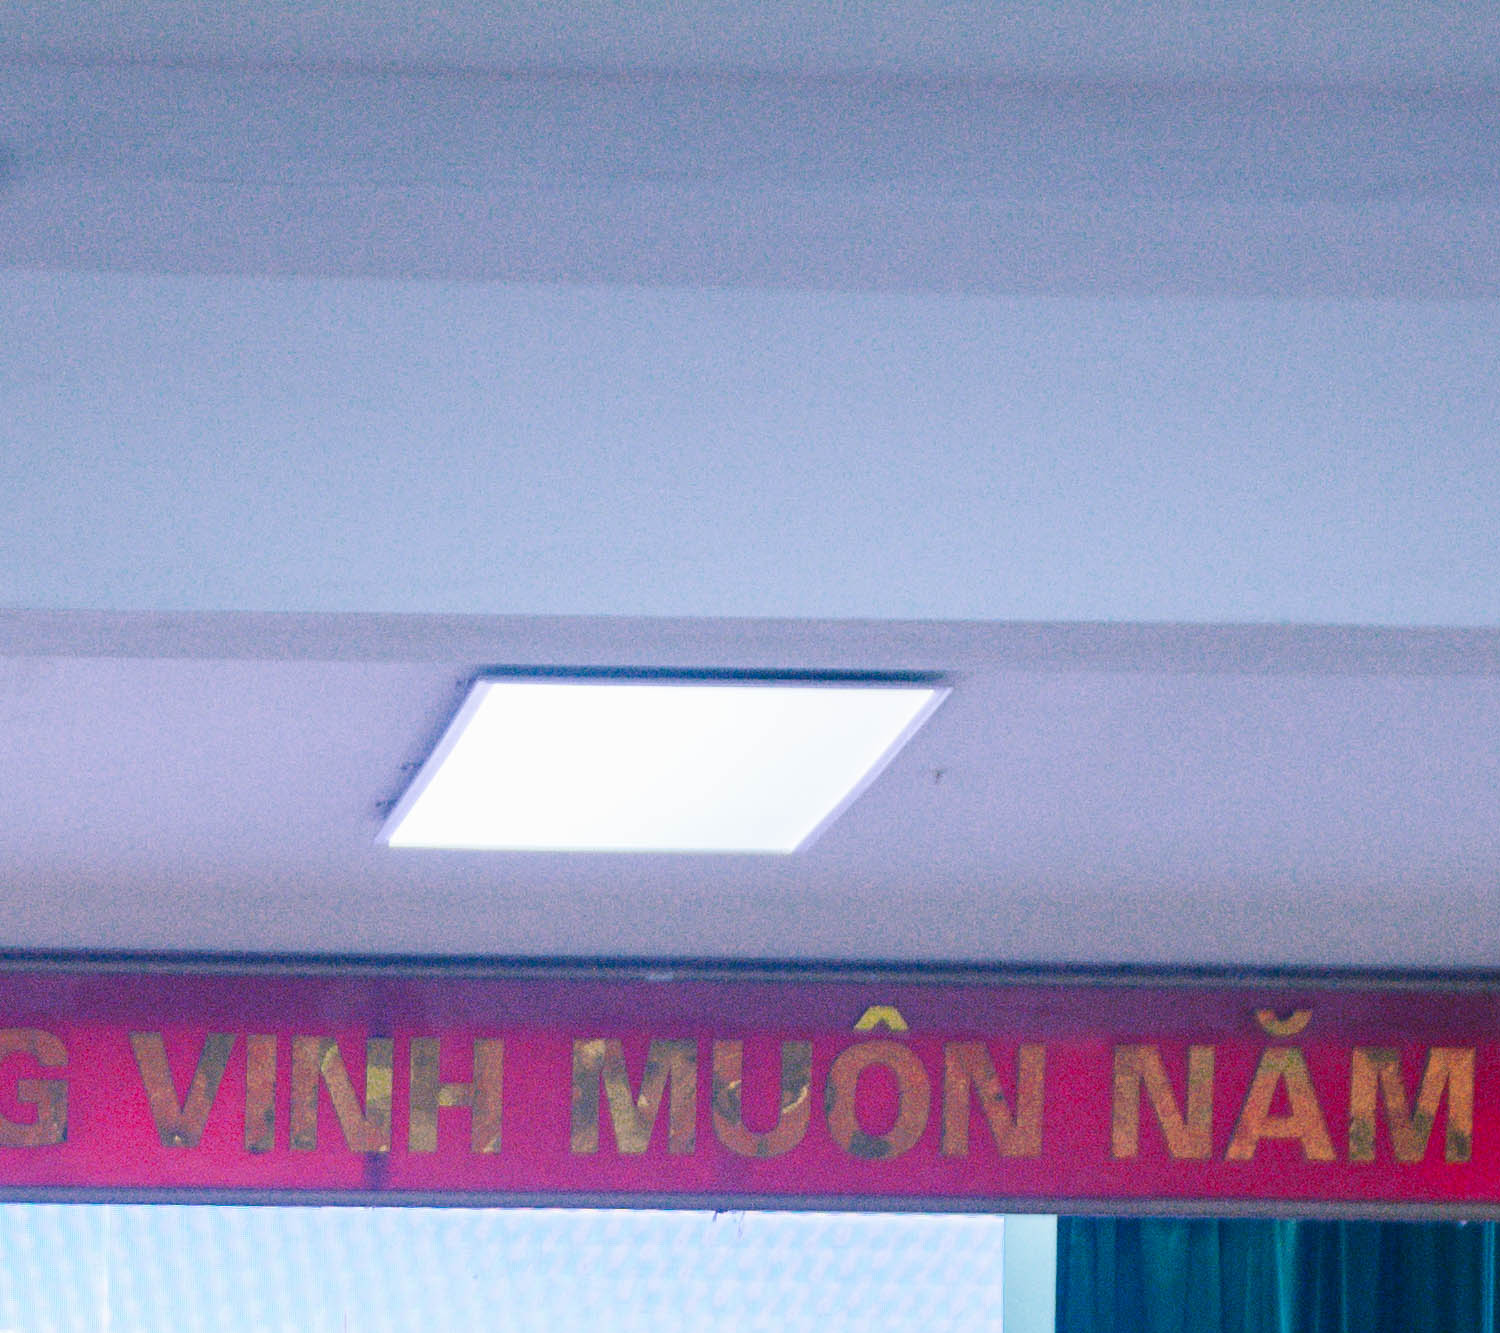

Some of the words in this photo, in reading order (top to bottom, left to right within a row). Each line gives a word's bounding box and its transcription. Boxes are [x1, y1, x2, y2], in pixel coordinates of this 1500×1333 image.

[129, 1032, 503, 1155] VINH
[570, 1004, 1045, 1160] MUÔN
[1111, 1007, 1477, 1163] NĂM
